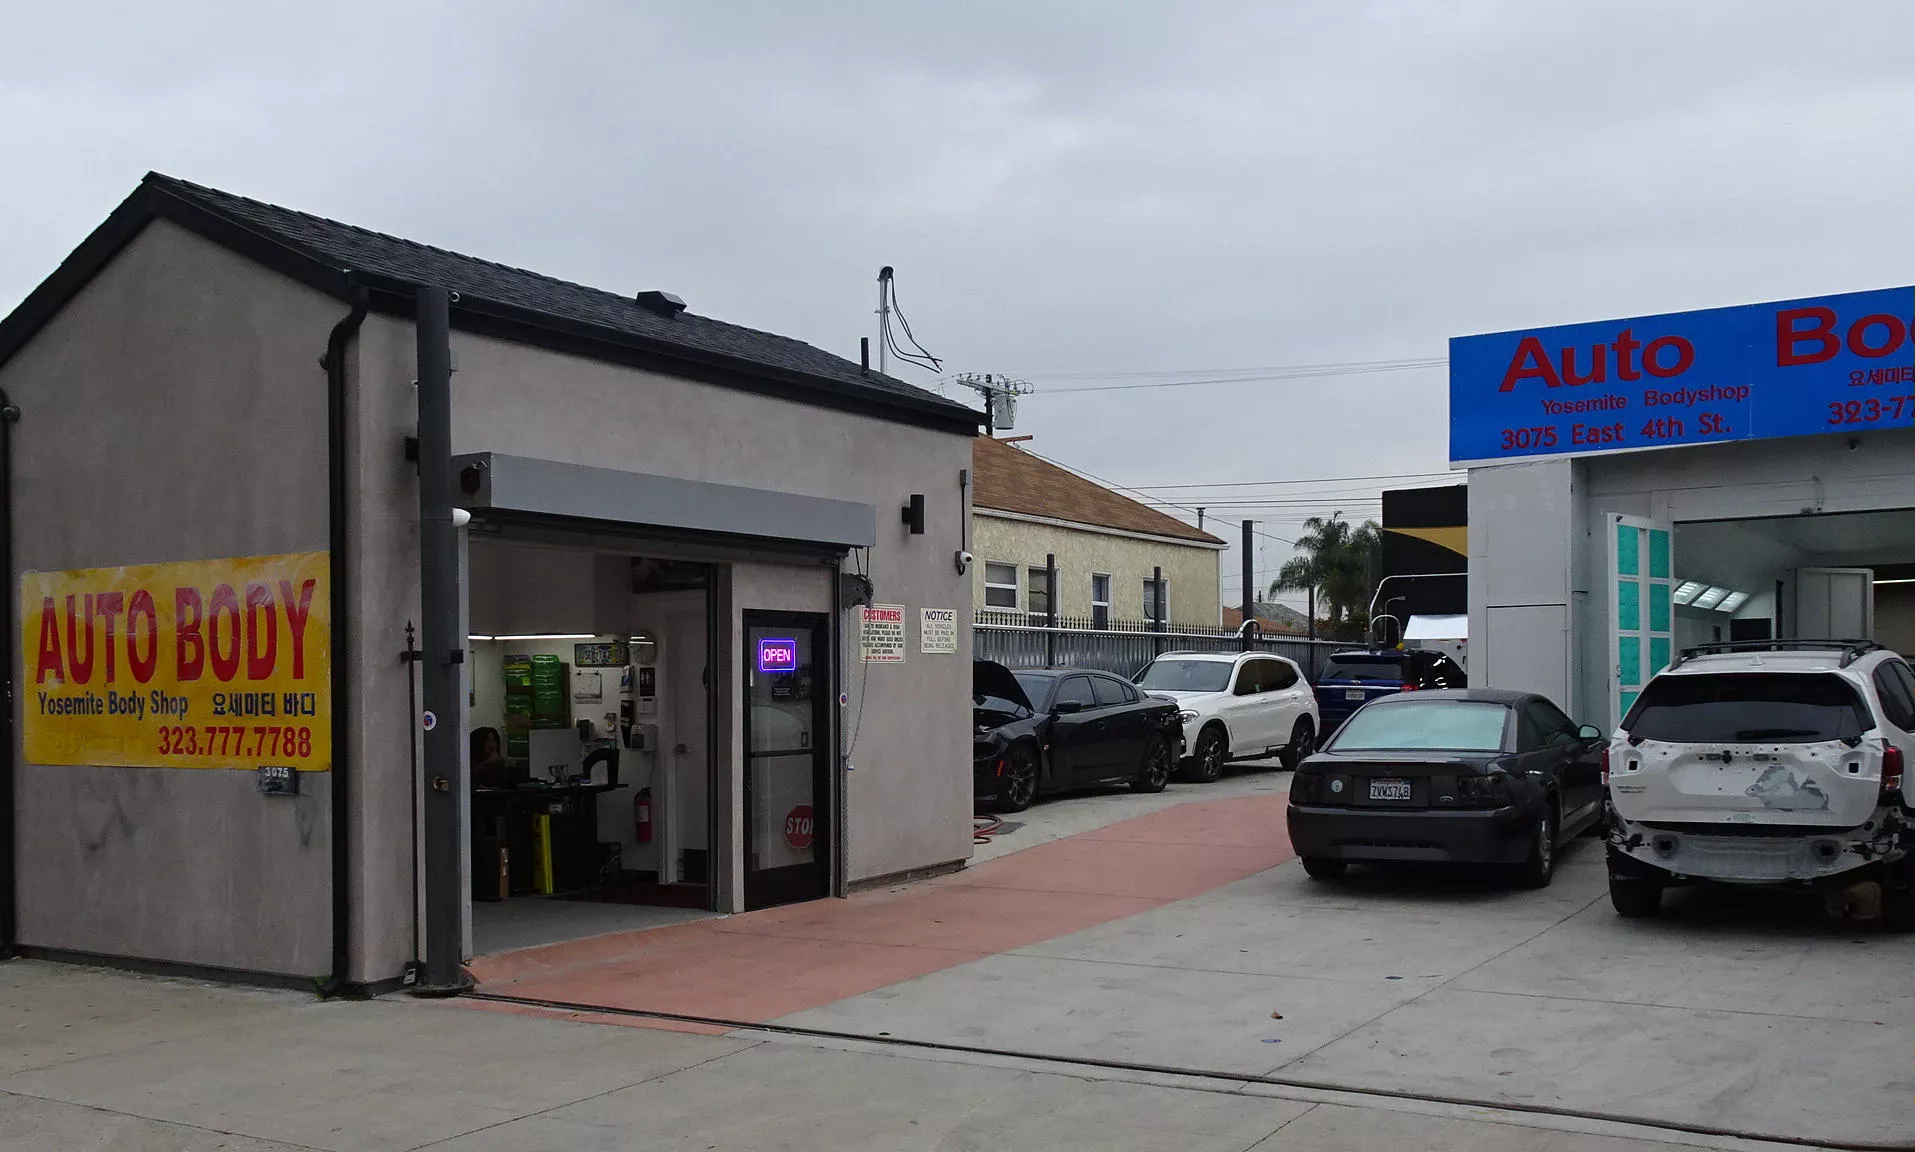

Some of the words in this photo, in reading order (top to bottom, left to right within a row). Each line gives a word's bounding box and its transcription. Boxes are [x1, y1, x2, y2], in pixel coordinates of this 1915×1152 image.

[1498, 328, 1695, 393] Auto
[1776, 306, 1915, 367] Bo
[1541, 393, 1628, 415] Yosemite
[1644, 384, 1750, 408] Bodyshop
[1501, 426, 1558, 450] 3075
[1571, 422, 1625, 445] East
[1640, 416, 1684, 439] 4th
[1698, 412, 1732, 435] St.
[864, 609, 901, 621] CUSTOMERS
[924, 610, 953, 621] NOTICE
[36, 589, 158, 685] AUTO
[175, 579, 316, 682] BODY
[763, 648, 791, 662] OPEN
[38, 691, 104, 715] Yosemite
[108, 690, 145, 721] Body
[150, 689, 189, 721] Shop
[212, 692, 276, 717] 요세미티
[283, 692, 316, 717] 바디
[158, 725, 312, 758] 323.777.7788
[265, 766, 289, 778] 3075
